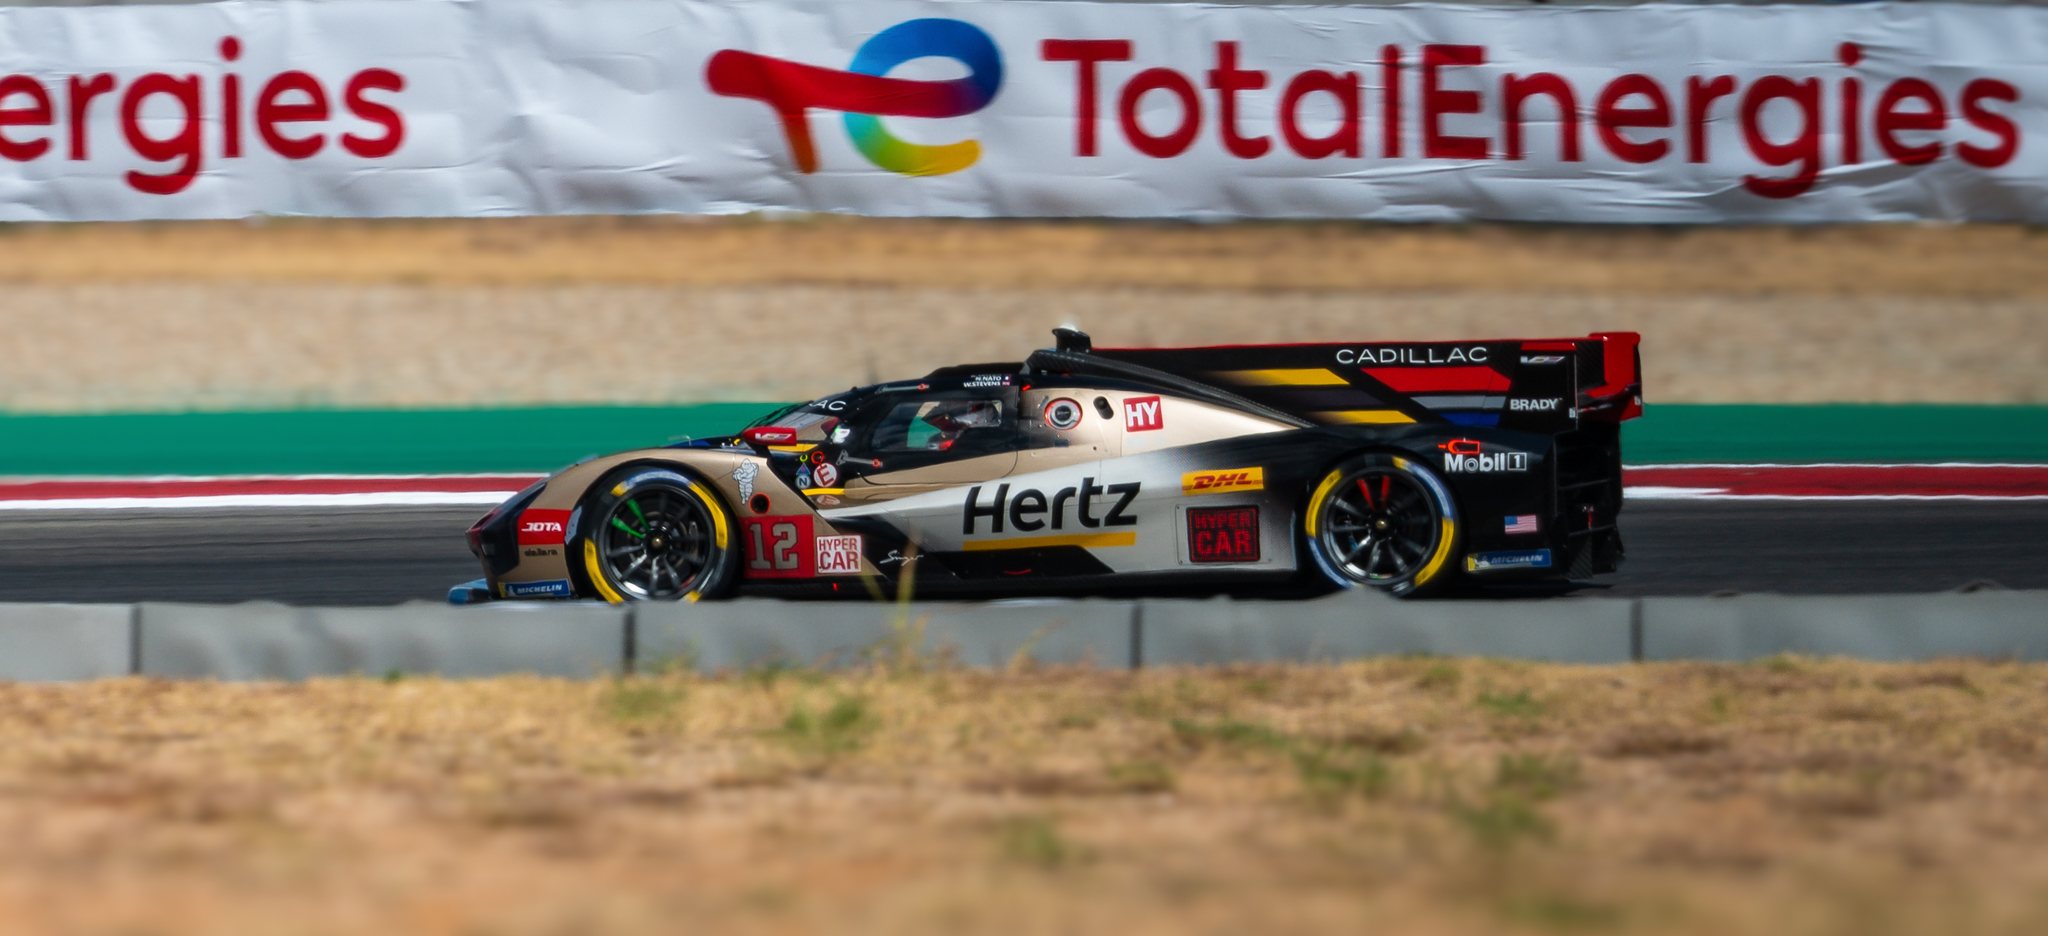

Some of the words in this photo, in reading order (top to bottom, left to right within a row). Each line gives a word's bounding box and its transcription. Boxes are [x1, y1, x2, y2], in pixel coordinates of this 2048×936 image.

[0, 36, 408, 194] ergies
[1040, 39, 2020, 198] TotalEnergies
[1336, 347, 1488, 364] CADILLAC
[1510, 399, 1559, 410] BRADY
[1125, 401, 1159, 428] HY
[1445, 453, 1505, 473] Mobil
[816, 464, 835, 487] E
[1193, 473, 1252, 490] DHL
[963, 477, 1142, 535] Hertz
[521, 522, 562, 532] JOTA
[1194, 512, 1251, 529] HYPER
[749, 522, 799, 570] 12
[818, 538, 858, 550] HYPER
[1195, 530, 1252, 556] CAR
[819, 551, 860, 570] CAR
[1491, 555, 1543, 564] MICHELIN
[517, 584, 563, 594] MICHELIN
